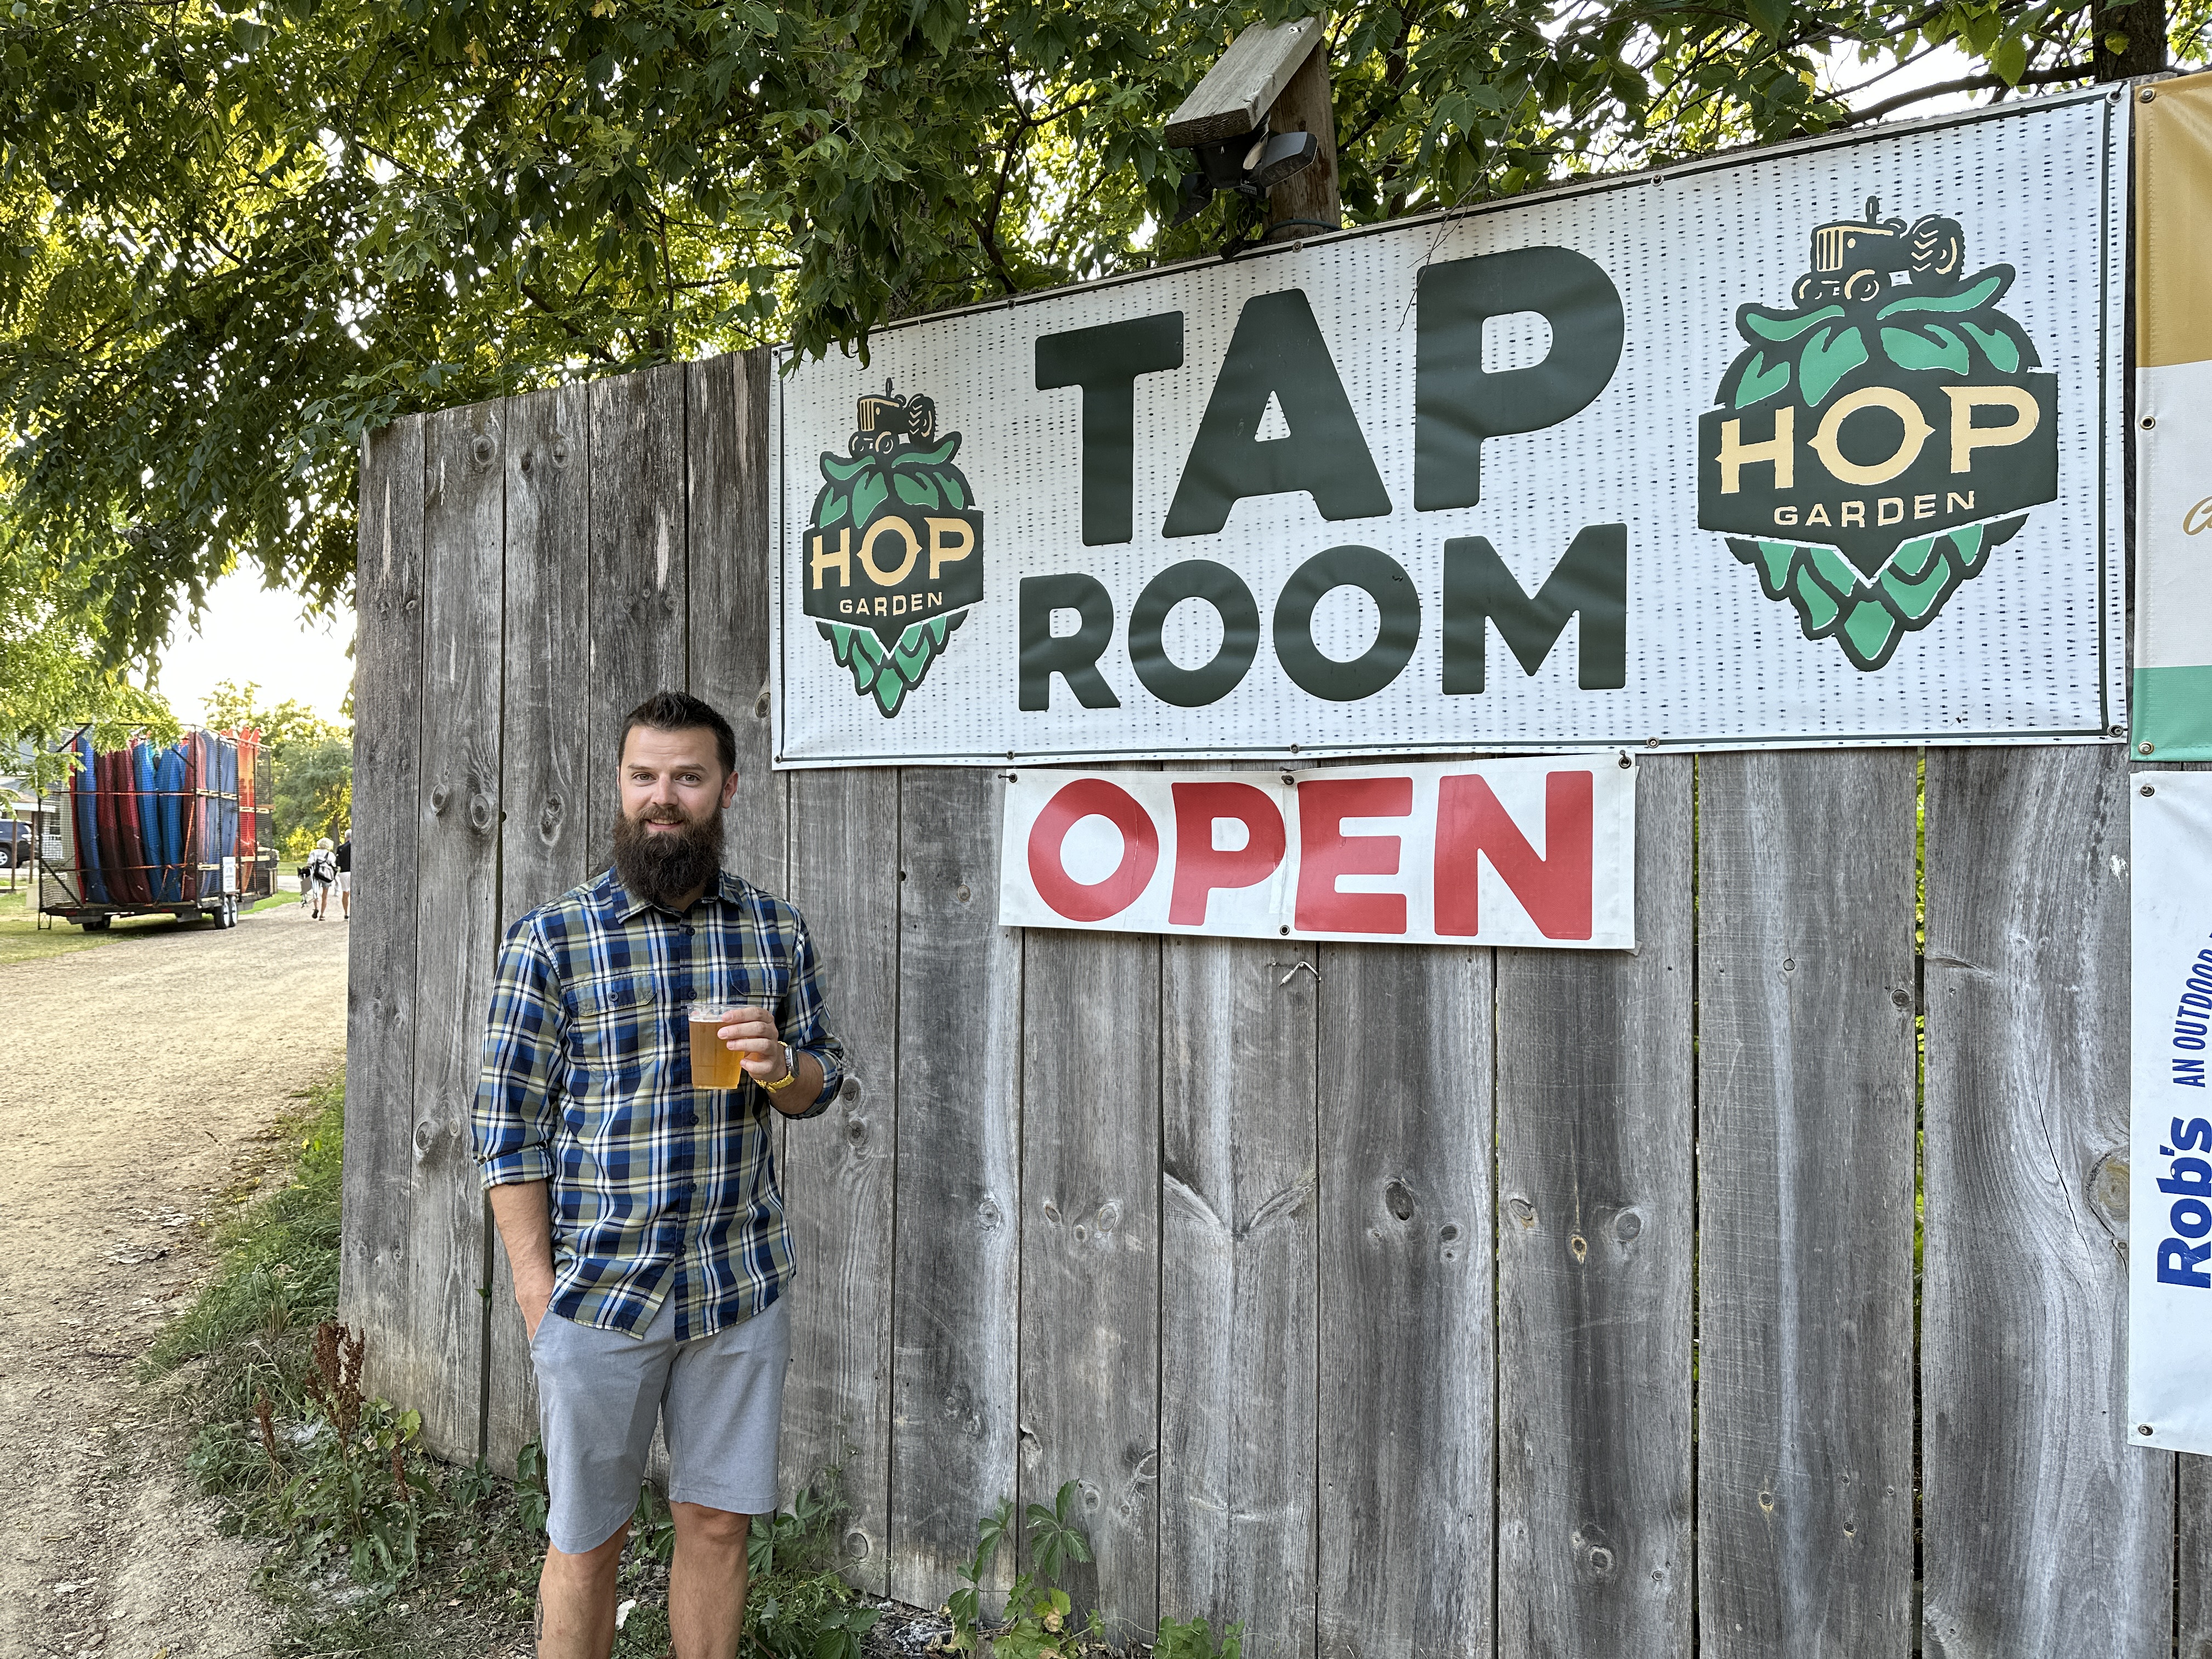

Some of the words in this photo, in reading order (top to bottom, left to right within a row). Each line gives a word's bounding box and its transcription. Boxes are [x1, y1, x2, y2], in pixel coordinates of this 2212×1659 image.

[1035, 246, 1624, 546] TAP
[1714, 386, 2040, 494] HOP
[810, 515, 974, 589] HOP
[1774, 490, 1975, 527] GARDEN
[839, 591, 942, 616] GARDEN
[1019, 523, 1627, 710] ROOM
[1028, 770, 1593, 940] OPEN
[2172, 1058, 2205, 1087] AN
[2156, 1116, 2212, 1289] Rob's
